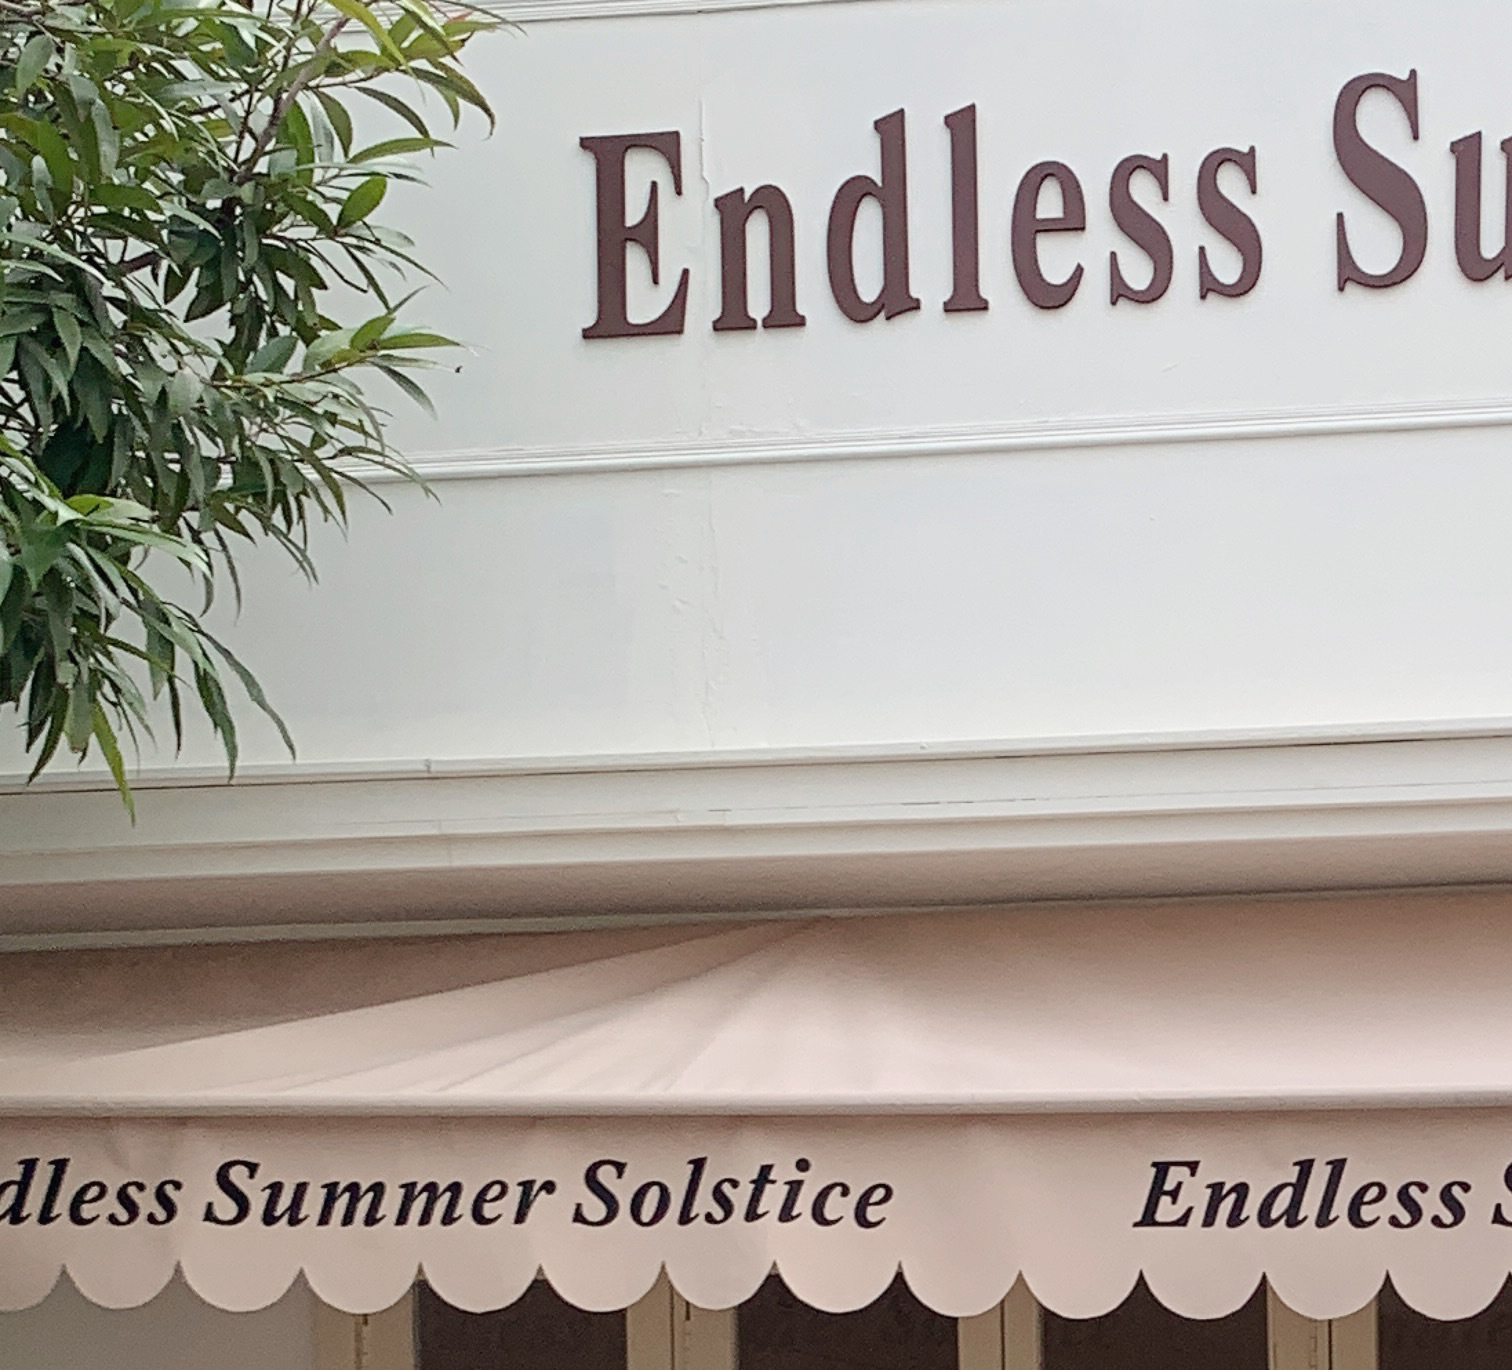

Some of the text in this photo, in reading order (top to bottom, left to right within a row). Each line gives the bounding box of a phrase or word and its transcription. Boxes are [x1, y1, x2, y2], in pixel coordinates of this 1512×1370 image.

[578, 102, 1263, 339] Endless
[0, 1155, 894, 1229] dless Summer Solstice
[1132, 1157, 1472, 1229] Endless
